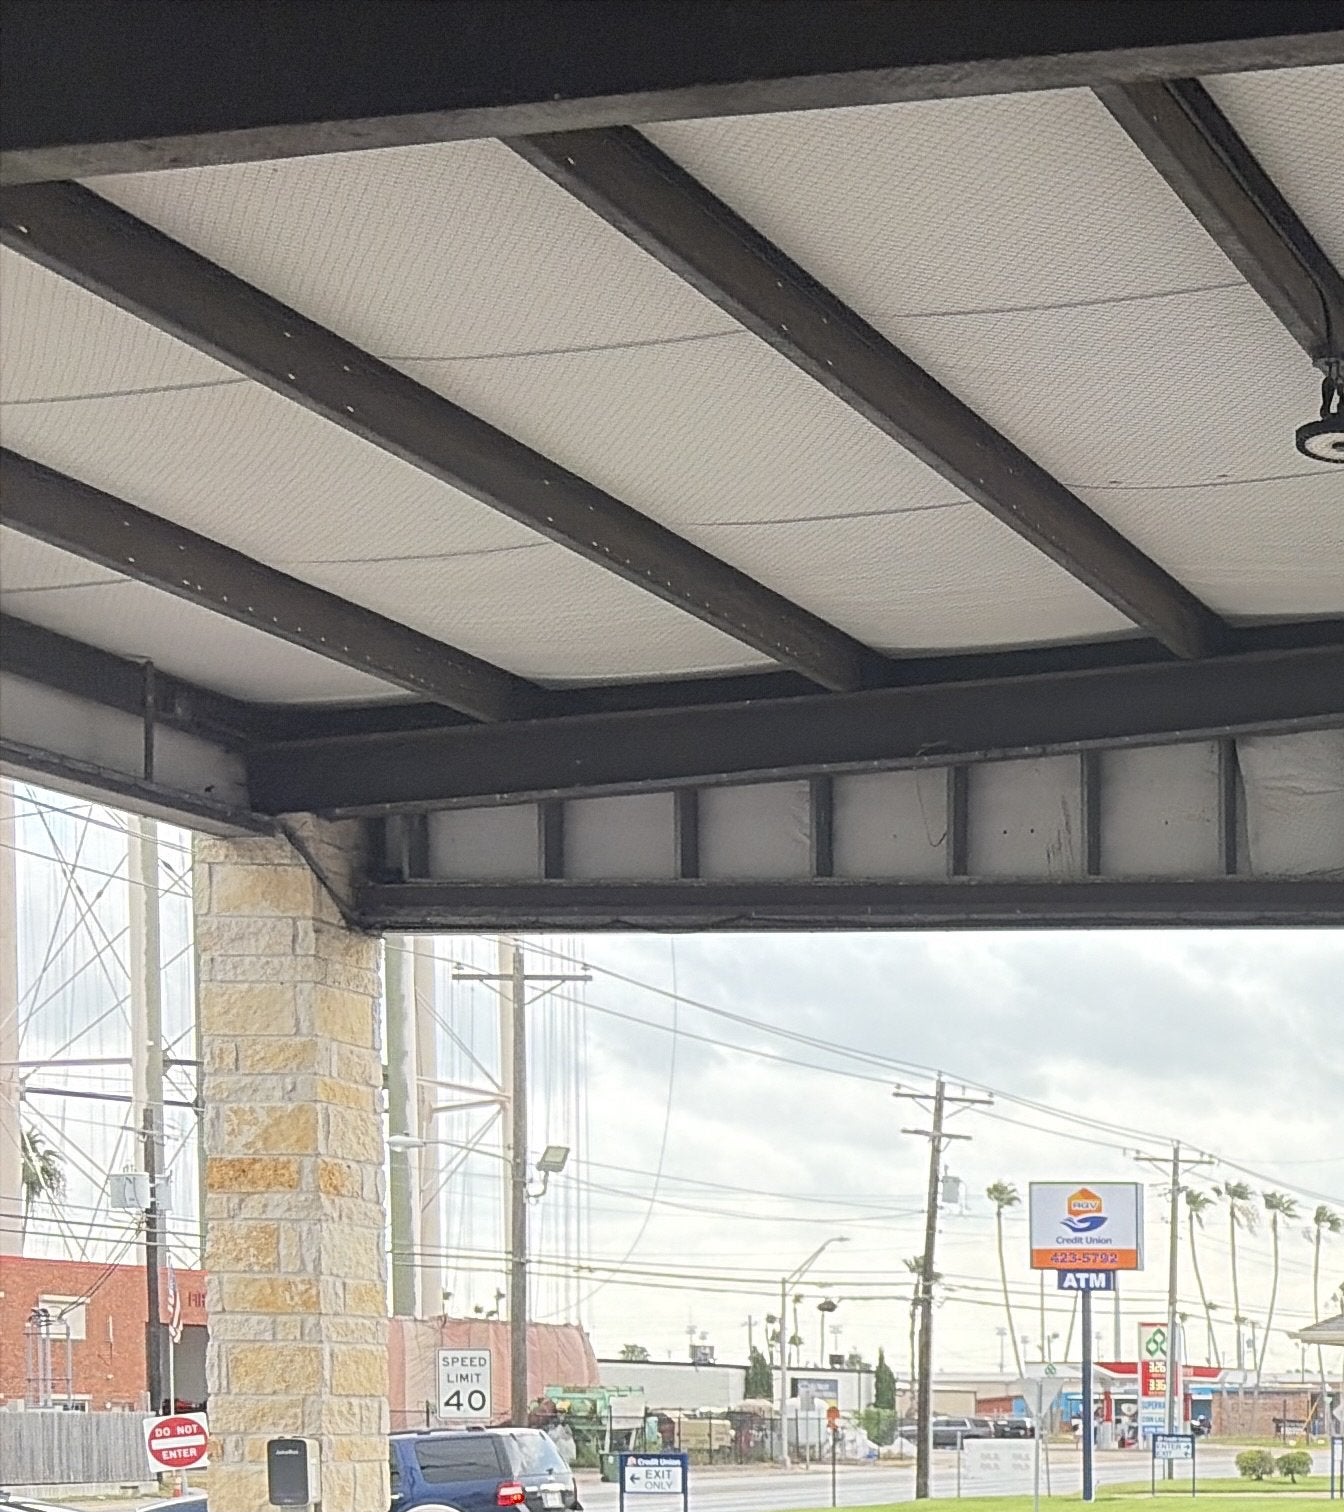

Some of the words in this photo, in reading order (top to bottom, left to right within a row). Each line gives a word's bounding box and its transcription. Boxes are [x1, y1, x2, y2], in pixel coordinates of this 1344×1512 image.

[1056, 1236, 1083, 1245] Credit
[1086, 1236, 1112, 1245] Union
[1051, 1252, 1117, 1264] 423-5792
[1063, 1273, 1106, 1288] ATM
[442, 1356, 487, 1367] SPEED
[447, 1373, 481, 1383] LIMIT
[444, 1389, 486, 1411] 40
[155, 1426, 171, 1437] DO
[177, 1424, 198, 1435] NOT
[162, 1447, 197, 1460] ENTER
[638, 1458, 658, 1466] Credit
[645, 1470, 672, 1479] EXIT
[645, 1481, 672, 1490] ONLY
